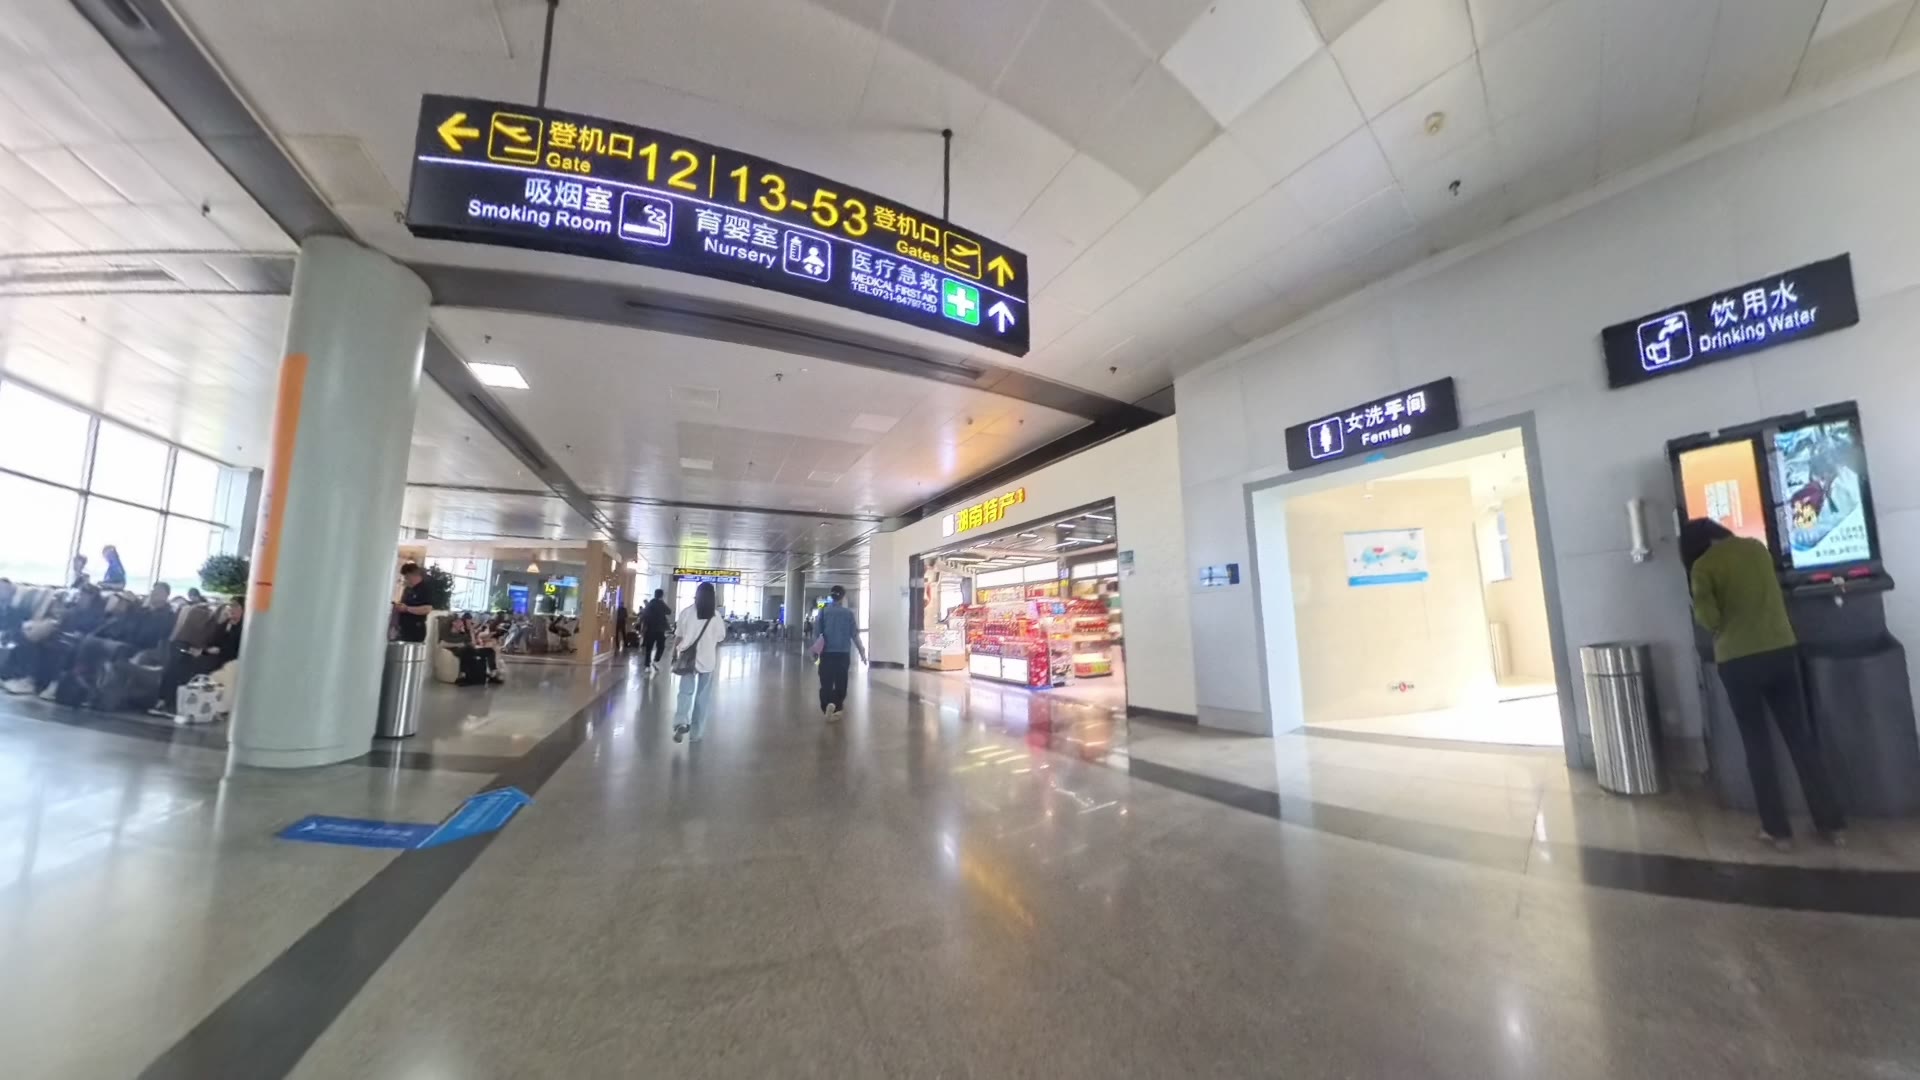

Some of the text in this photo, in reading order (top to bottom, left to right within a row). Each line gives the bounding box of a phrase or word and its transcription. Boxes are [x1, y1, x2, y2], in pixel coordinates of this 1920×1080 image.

[546, 153, 591, 174] Gate
[549, 121, 700, 190] 登机口 12
[525, 177, 613, 214] 吸烟室
[730, 165, 940, 247] 13-53 登机口
[467, 199, 612, 234] Smoking Room
[696, 208, 779, 250] 育婴室
[704, 236, 776, 269] Nursery
[851, 249, 939, 293] 医疗急救
[896, 240, 940, 265] Gates
[851, 271, 938, 305] MEDICAL FIRST AID
[1710, 280, 1798, 328] 饮用水
[1700, 307, 1817, 352] Drinking Water
[1345, 391, 1427, 433] 女洗手间
[1361, 424, 1411, 446] Female
